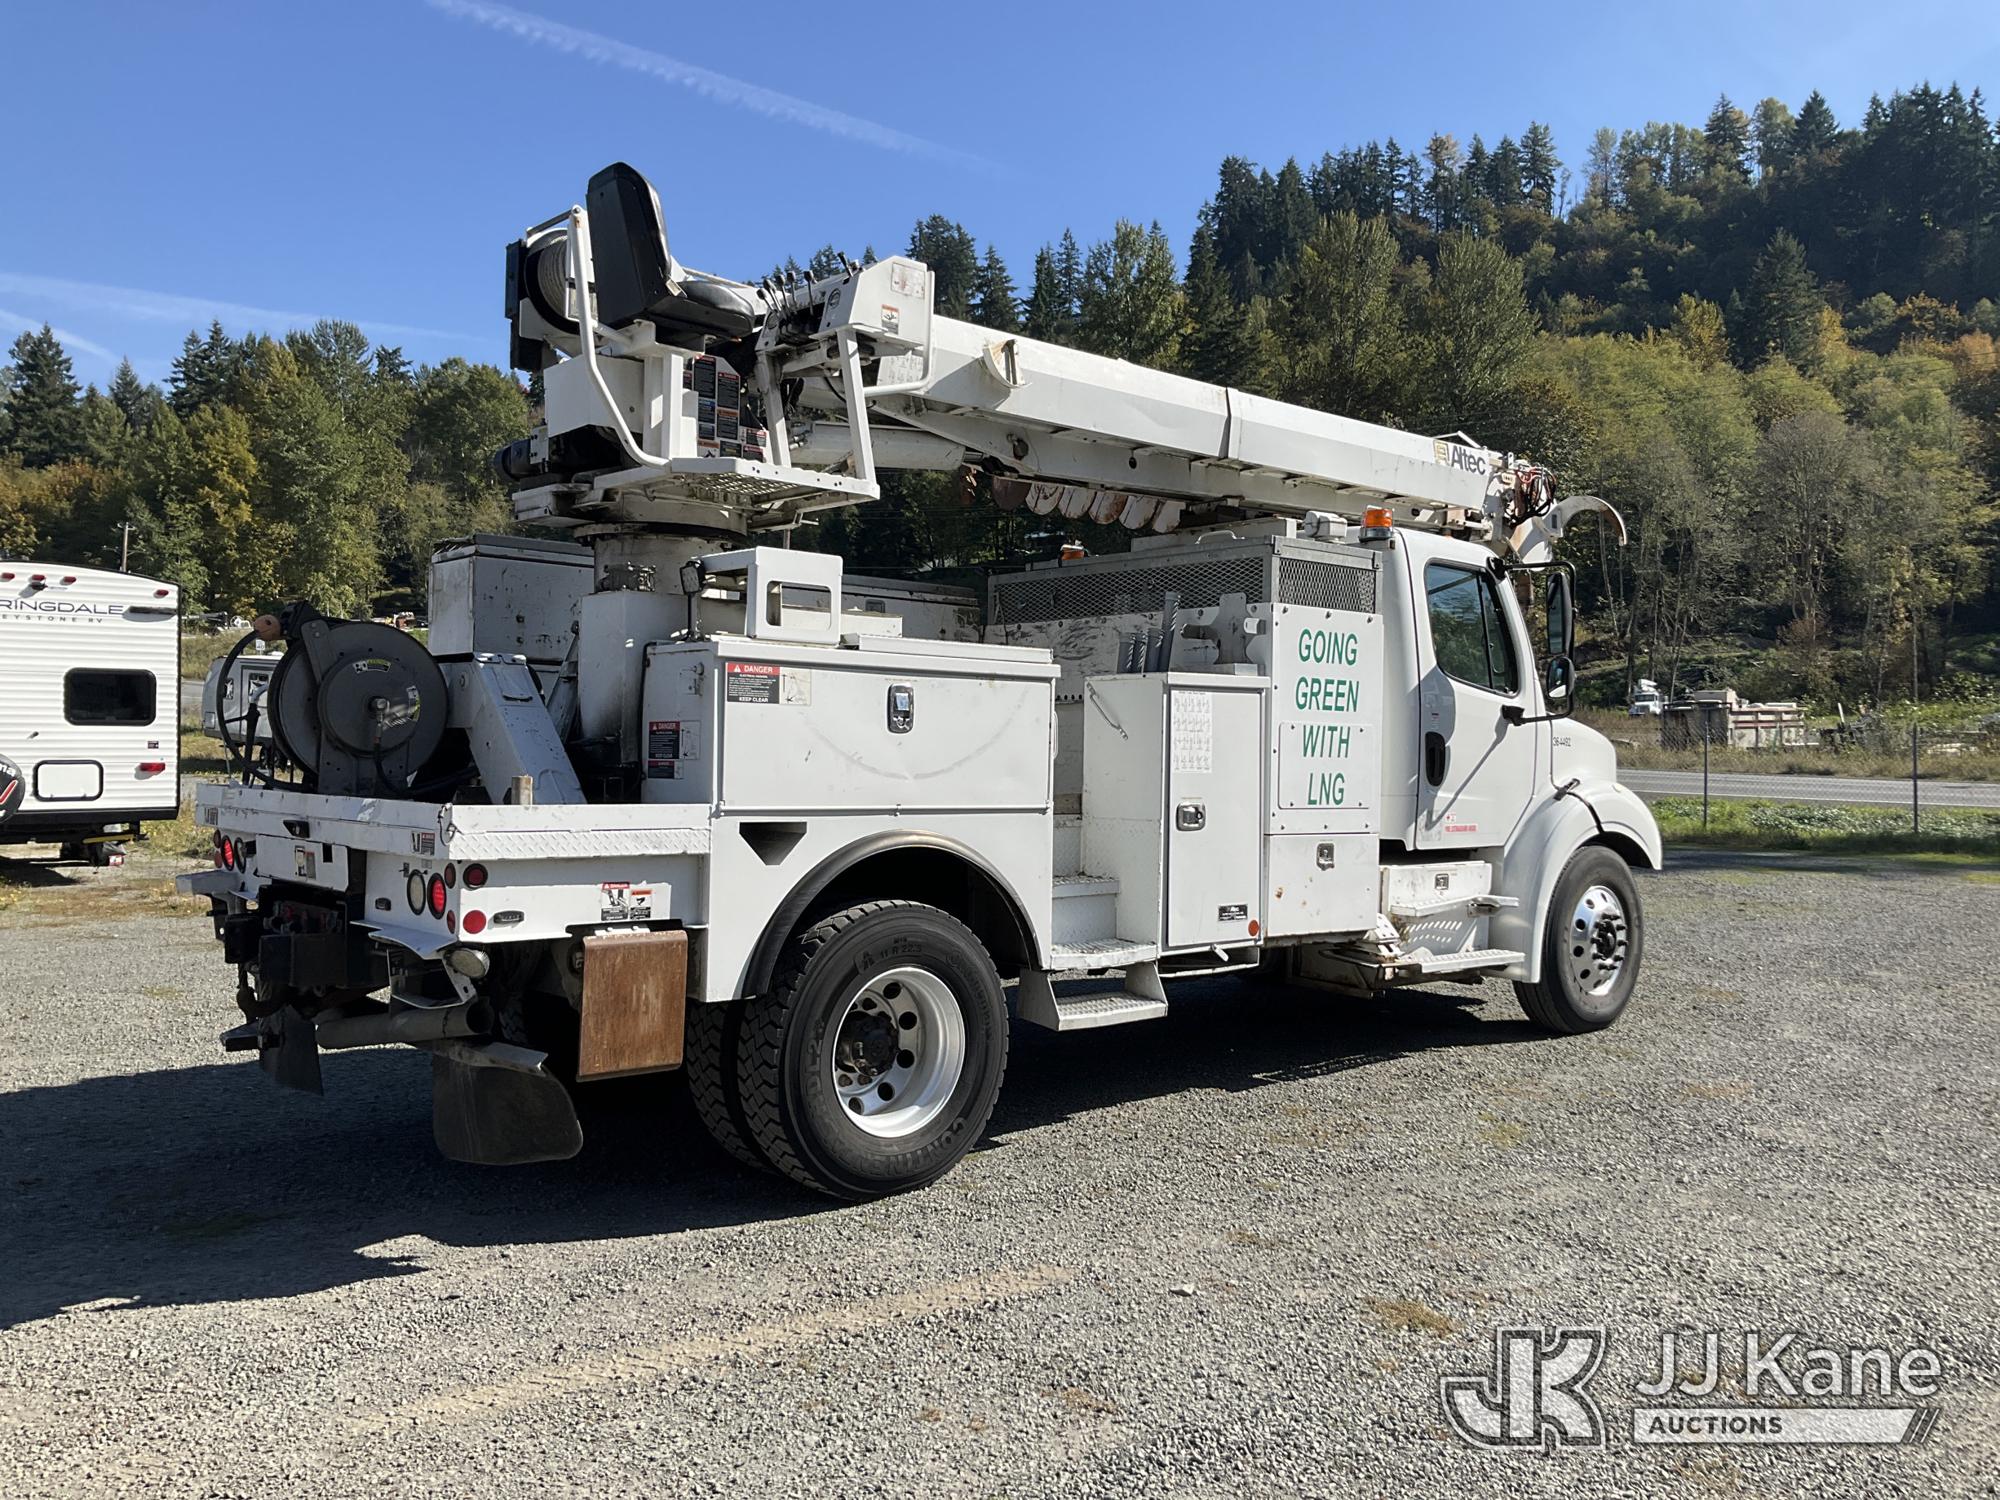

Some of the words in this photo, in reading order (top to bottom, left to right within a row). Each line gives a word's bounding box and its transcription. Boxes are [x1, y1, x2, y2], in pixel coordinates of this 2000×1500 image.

[1451, 445, 1486, 475] Altec
[1298, 628, 1358, 666] GOING
[743, 664, 774, 674] DANGER
[1296, 676, 1360, 713] GREEN
[1303, 724, 1351, 758] WITH
[1307, 772, 1345, 806] LNG
